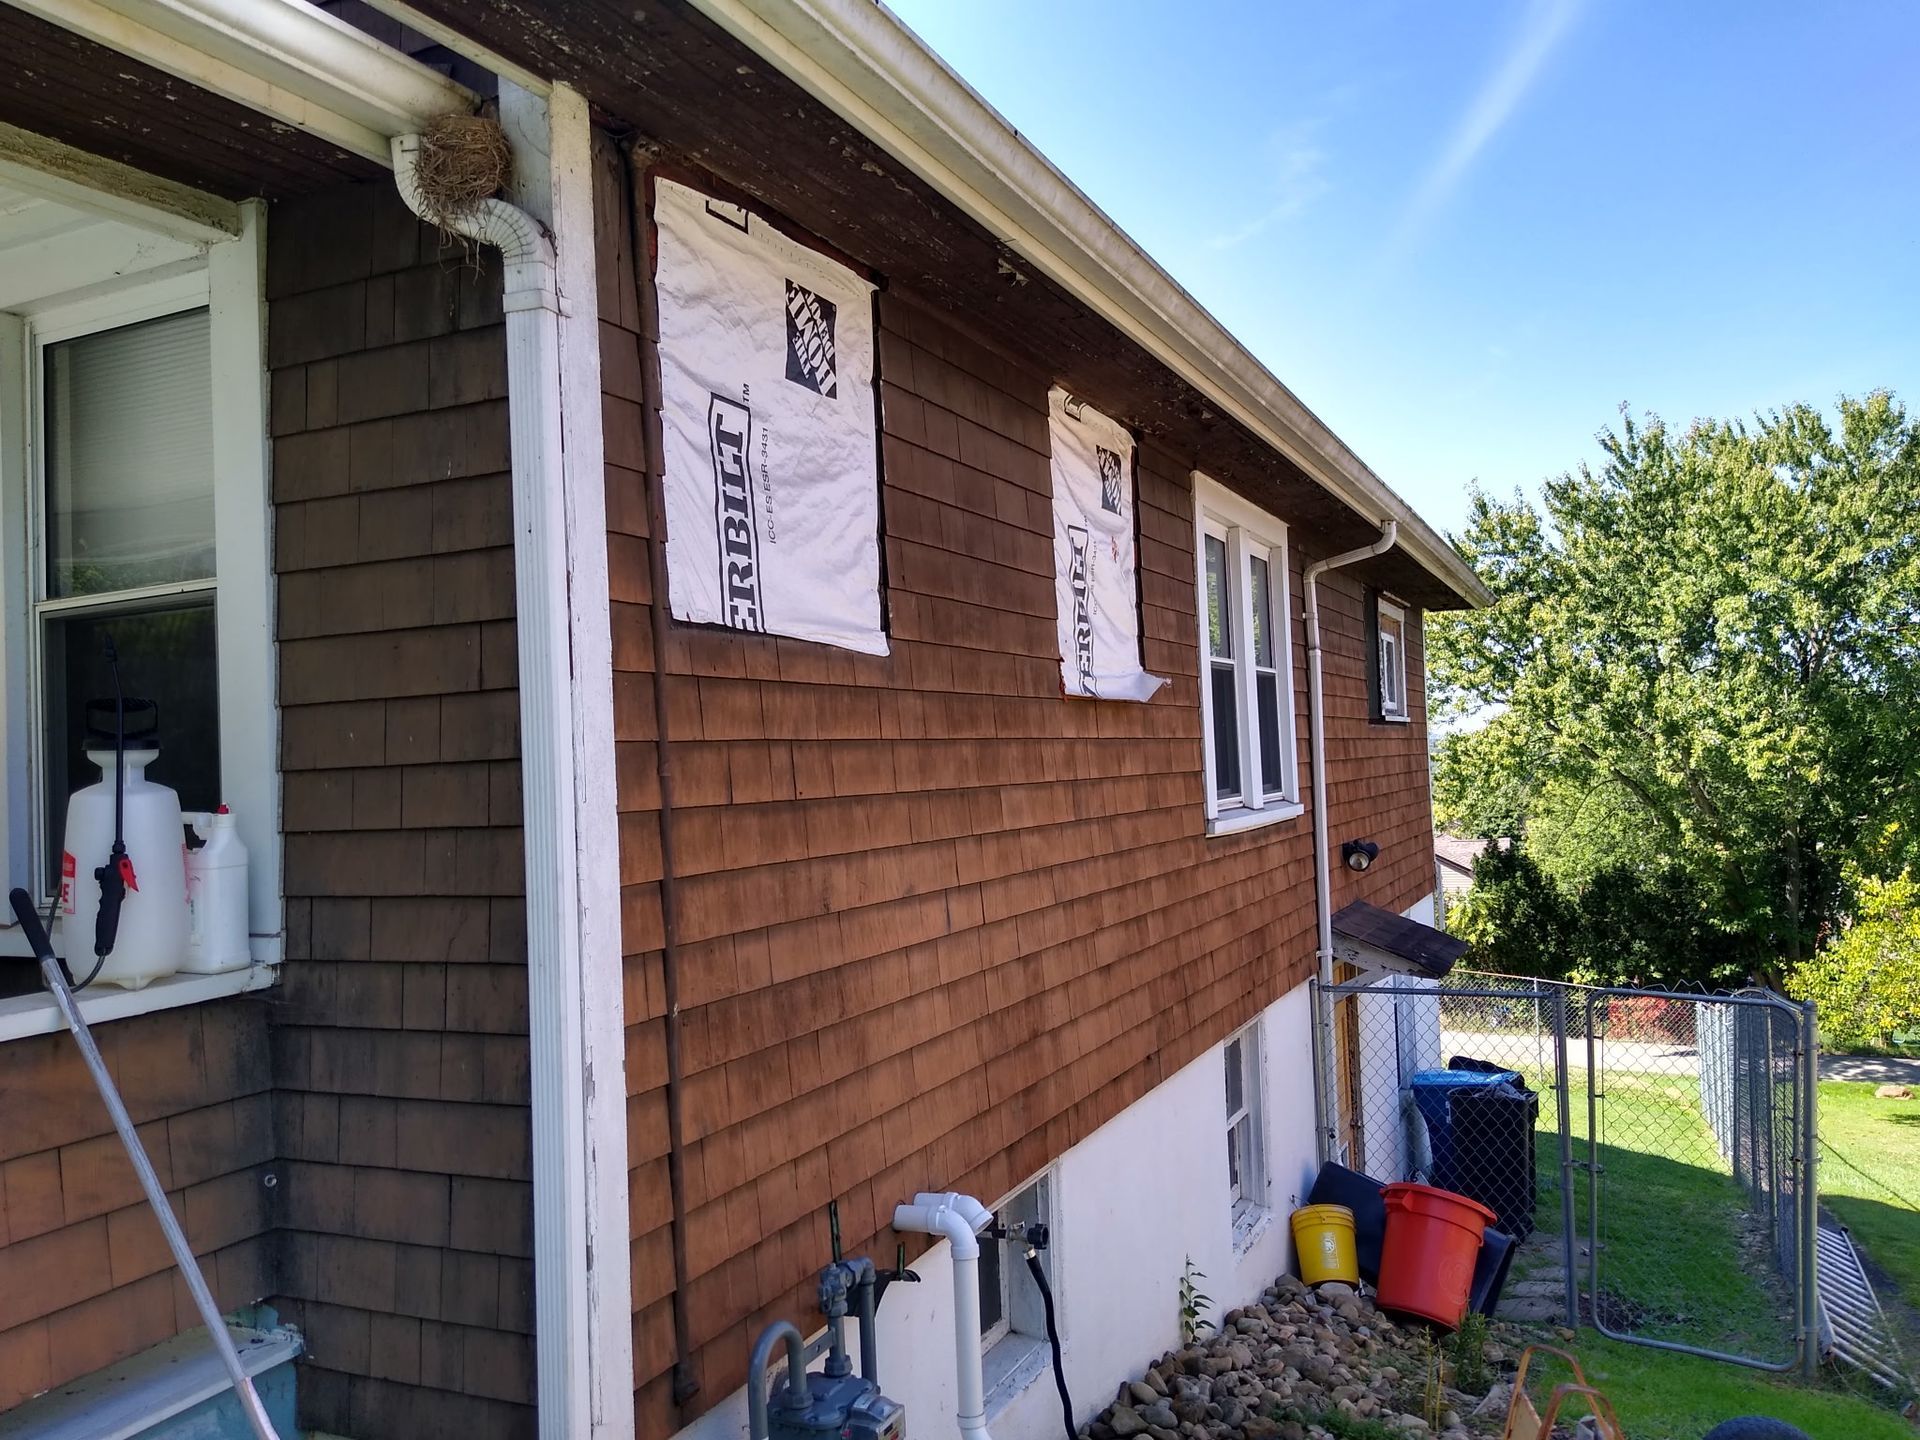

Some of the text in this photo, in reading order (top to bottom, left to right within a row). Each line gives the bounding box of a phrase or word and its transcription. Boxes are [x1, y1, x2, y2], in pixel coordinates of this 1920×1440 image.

[785, 281, 836, 396] HOME
[792, 331, 810, 379] THE
[805, 291, 835, 361] DEPOT
[761, 427, 776, 544] ICC-ES ESR-3431
